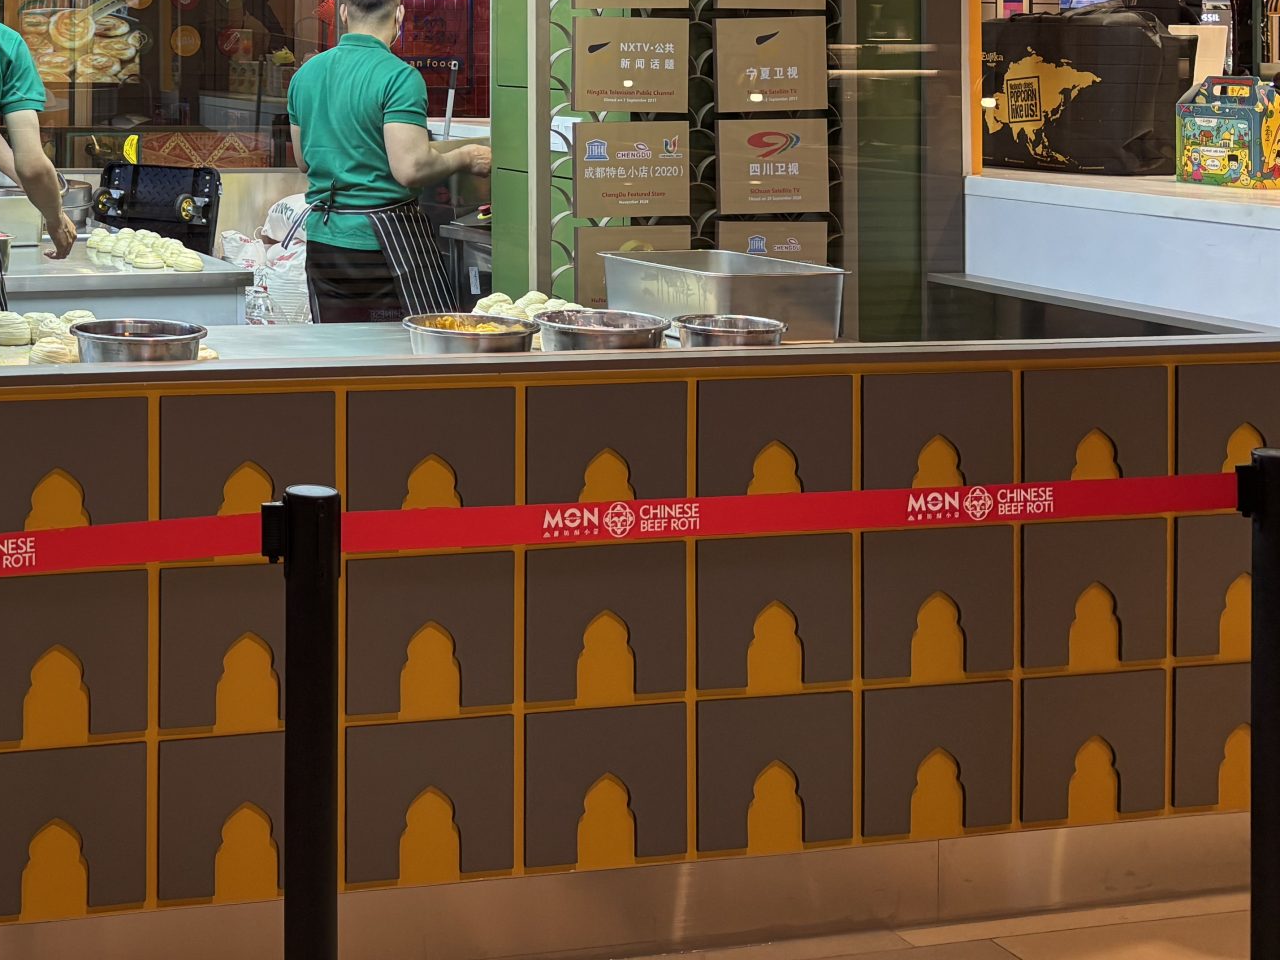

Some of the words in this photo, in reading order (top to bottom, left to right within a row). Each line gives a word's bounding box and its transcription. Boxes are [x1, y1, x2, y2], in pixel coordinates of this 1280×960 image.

[620, 58, 674, 69] 新闻话题
[746, 67, 798, 80] 宁夏卫视
[1009, 88, 1037, 103] POPCORN
[1010, 103, 1024, 119] like
[1024, 101, 1038, 118] us!
[749, 163, 799, 176] 四川卫视
[907, 491, 959, 512] MON
[997, 487, 1053, 503] CHINESE
[543, 507, 599, 528] MON
[640, 503, 700, 519] CHINESE
[998, 501, 1024, 515] BEEF
[1026, 501, 1054, 513] ROTI
[640, 519, 668, 532] BEEF
[671, 517, 700, 531] ROTI
[3, 553, 36, 568] ROTI
